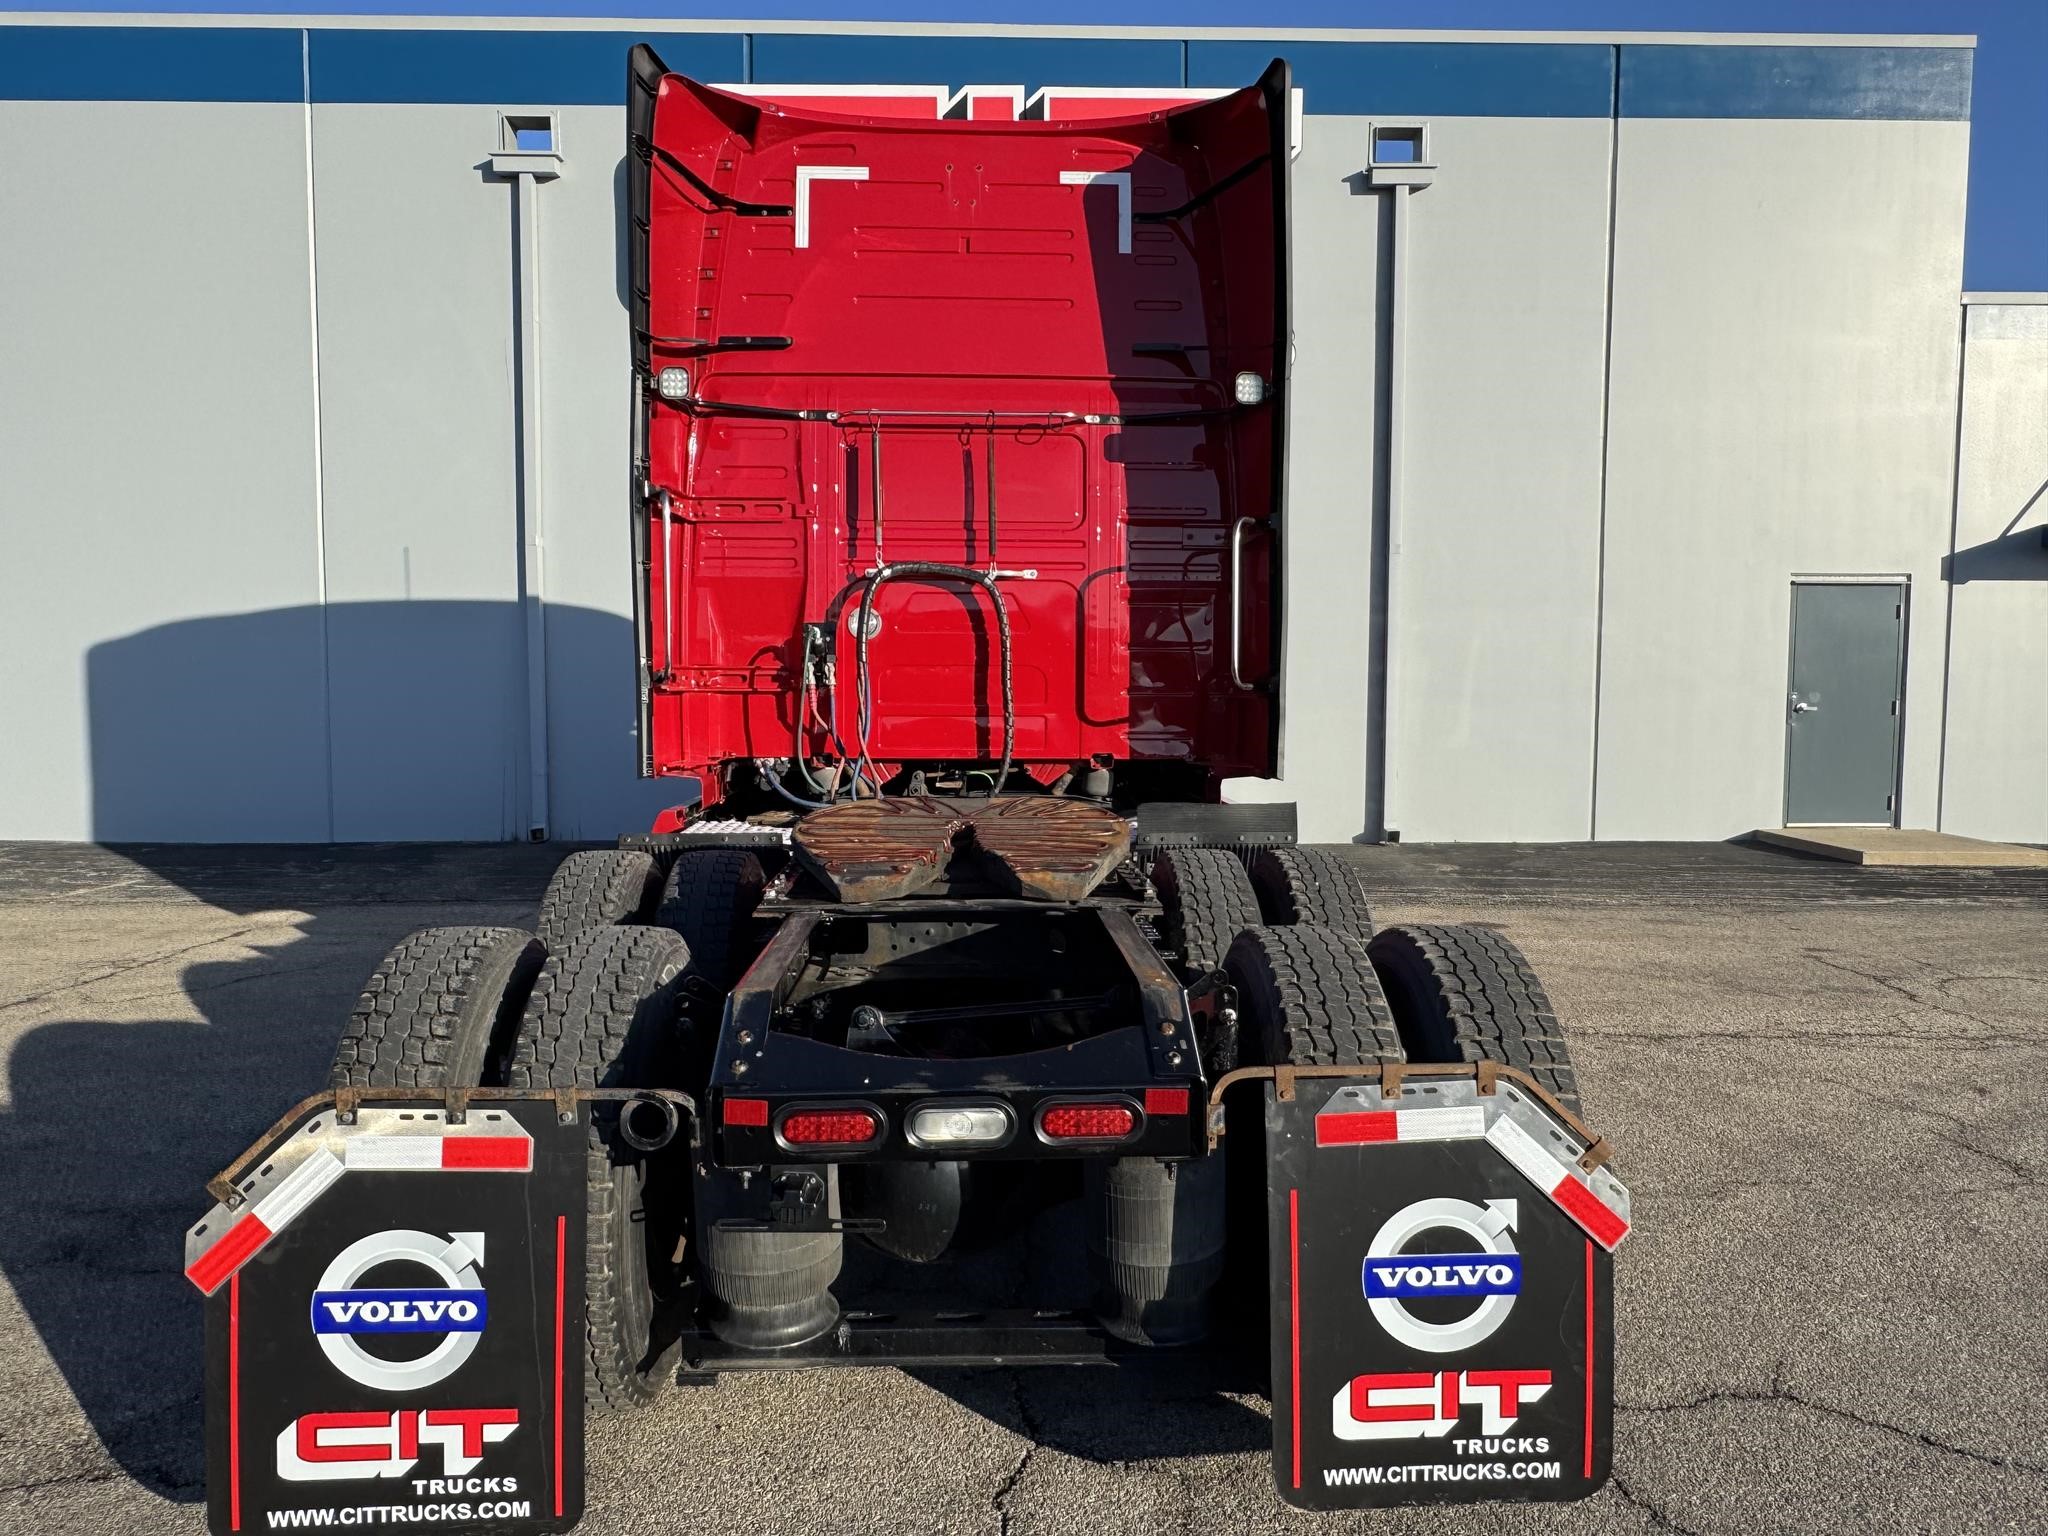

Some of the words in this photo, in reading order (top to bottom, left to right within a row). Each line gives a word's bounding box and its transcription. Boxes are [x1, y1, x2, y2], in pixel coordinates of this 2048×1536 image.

[1373, 1265, 1515, 1287] VOLVO
[322, 1301, 479, 1323] VOLVO
[1333, 1370, 1552, 1440] CIT
[277, 1409, 519, 1480] CIT
[1453, 1438, 1550, 1455] TRUCKS
[1324, 1462, 1561, 1486] WWW.CITTRUCKS.COM
[412, 1477, 518, 1495] TRUCKS
[267, 1501, 531, 1528] WWW.CITTRUCKS.COM
